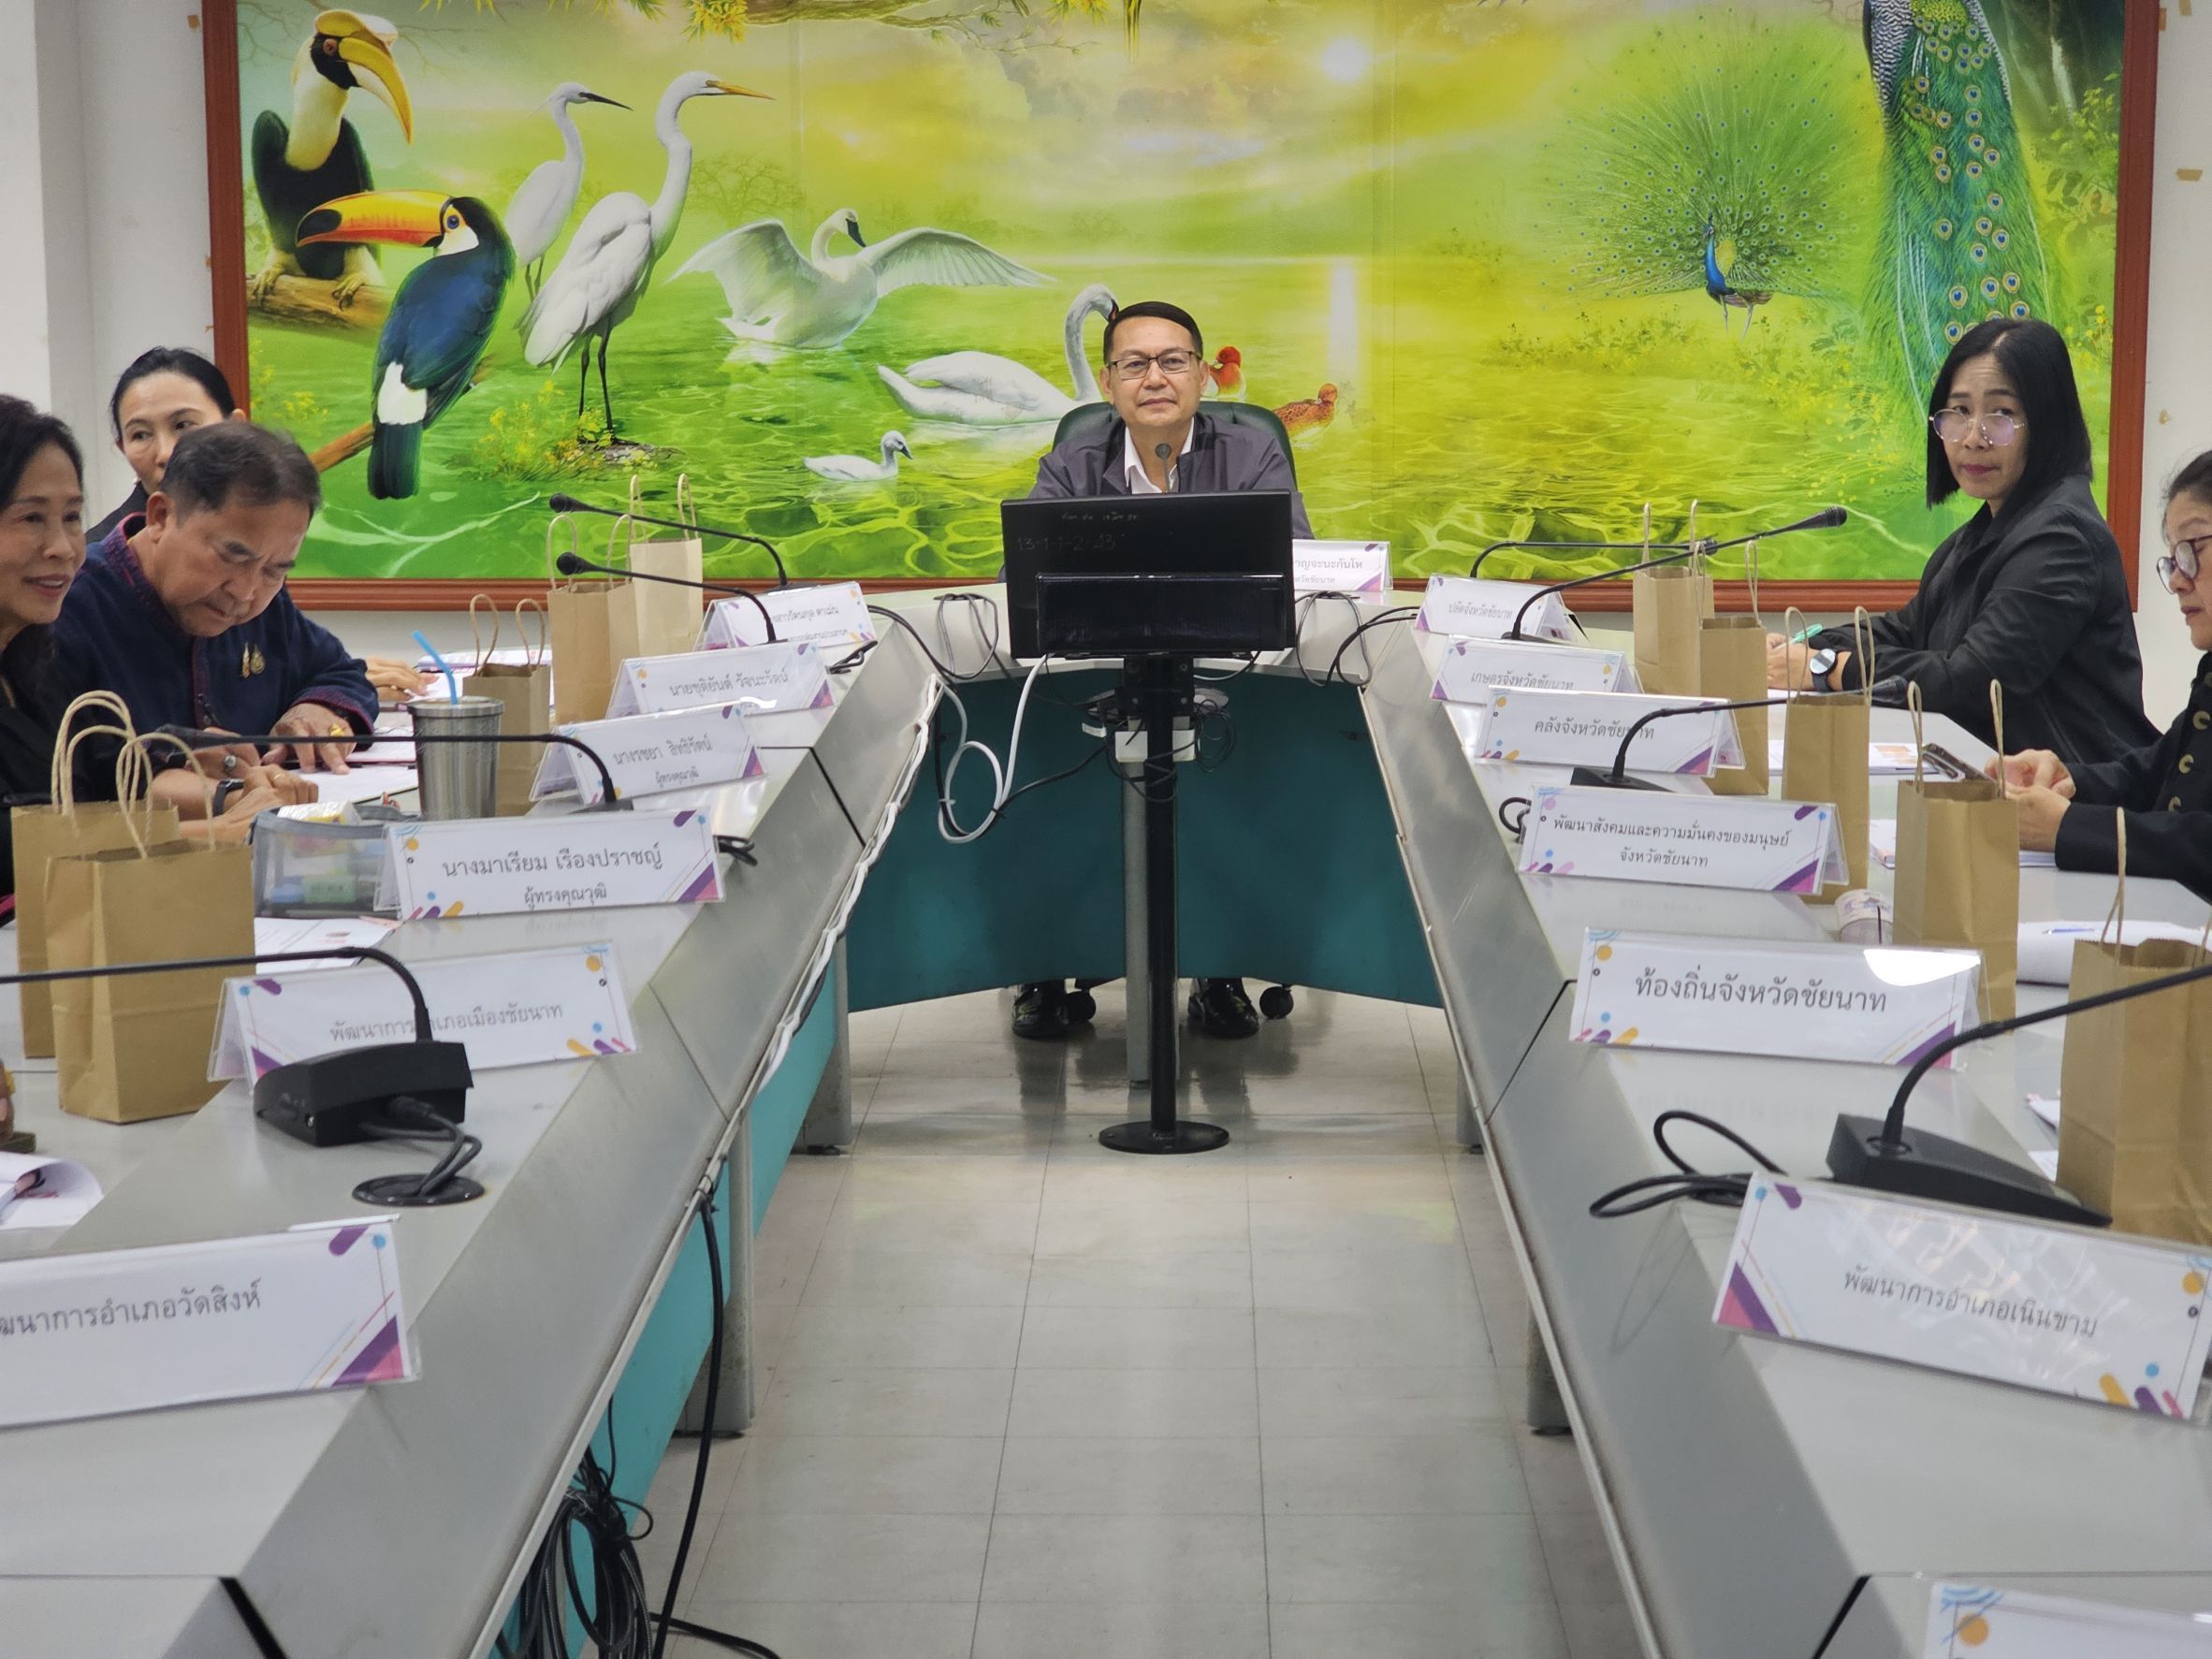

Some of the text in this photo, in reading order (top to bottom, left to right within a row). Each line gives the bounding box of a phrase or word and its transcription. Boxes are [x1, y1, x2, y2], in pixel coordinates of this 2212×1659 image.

[1295, 558, 1362, 570] าญจะนะกันโห
[1534, 717, 1654, 739] คลังจังหวัดชัยาท
[1553, 814, 1792, 851] พัฒนาสังคมและความมั่นคงของมนุษย์
[443, 841, 662, 877] นางมาเรียม เรืองปราชญ์
[1620, 847, 1709, 867] จังหวัดชัยนาท
[524, 882, 607, 909] ผู้ทรงคุณวุฒิ
[1635, 965, 1886, 1011] ท้องถิ่นจังหวัดชัยนาท
[330, 1002, 563, 1041] พัฒนาการเภอเมืองชัยนาท
[0, 1278, 262, 1336] ฒนาการอำเภอวัดสิงห์
[1844, 1265, 2098, 1338] พัฒนาการอำเภอเนินขาม
